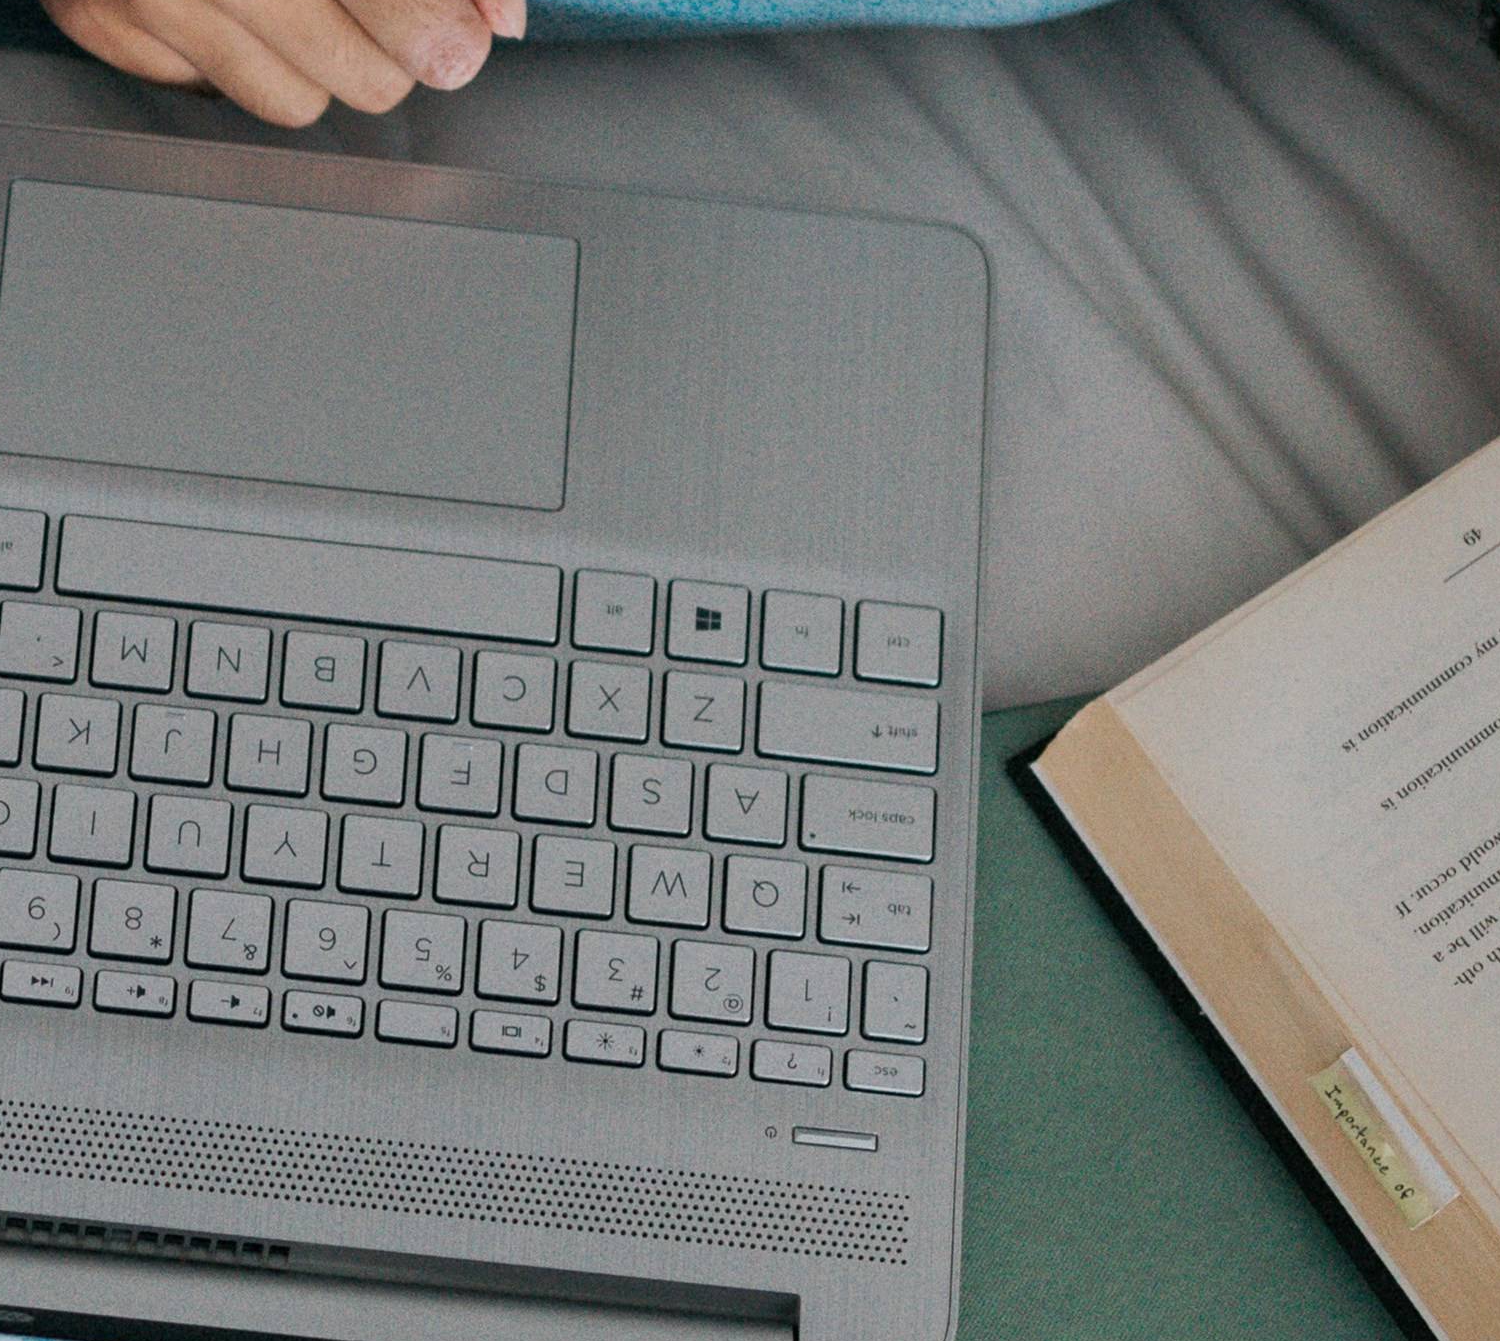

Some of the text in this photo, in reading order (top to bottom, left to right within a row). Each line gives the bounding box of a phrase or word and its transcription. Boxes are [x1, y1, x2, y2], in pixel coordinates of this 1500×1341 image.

[603, 602, 624, 618] alt
[792, 623, 810, 639] fn
[884, 633, 911, 650] ctrl
[885, 723, 919, 741] shift
[845, 806, 916, 827] caps lock
[463, 848, 492, 878] R
[561, 858, 586, 888] E
[649, 868, 689, 899] W
[748, 876, 781, 909] Q
[885, 901, 912, 918] tab
[871, 1062, 899, 1079] esc
[1317, 1080, 1417, 1203] Importance of
